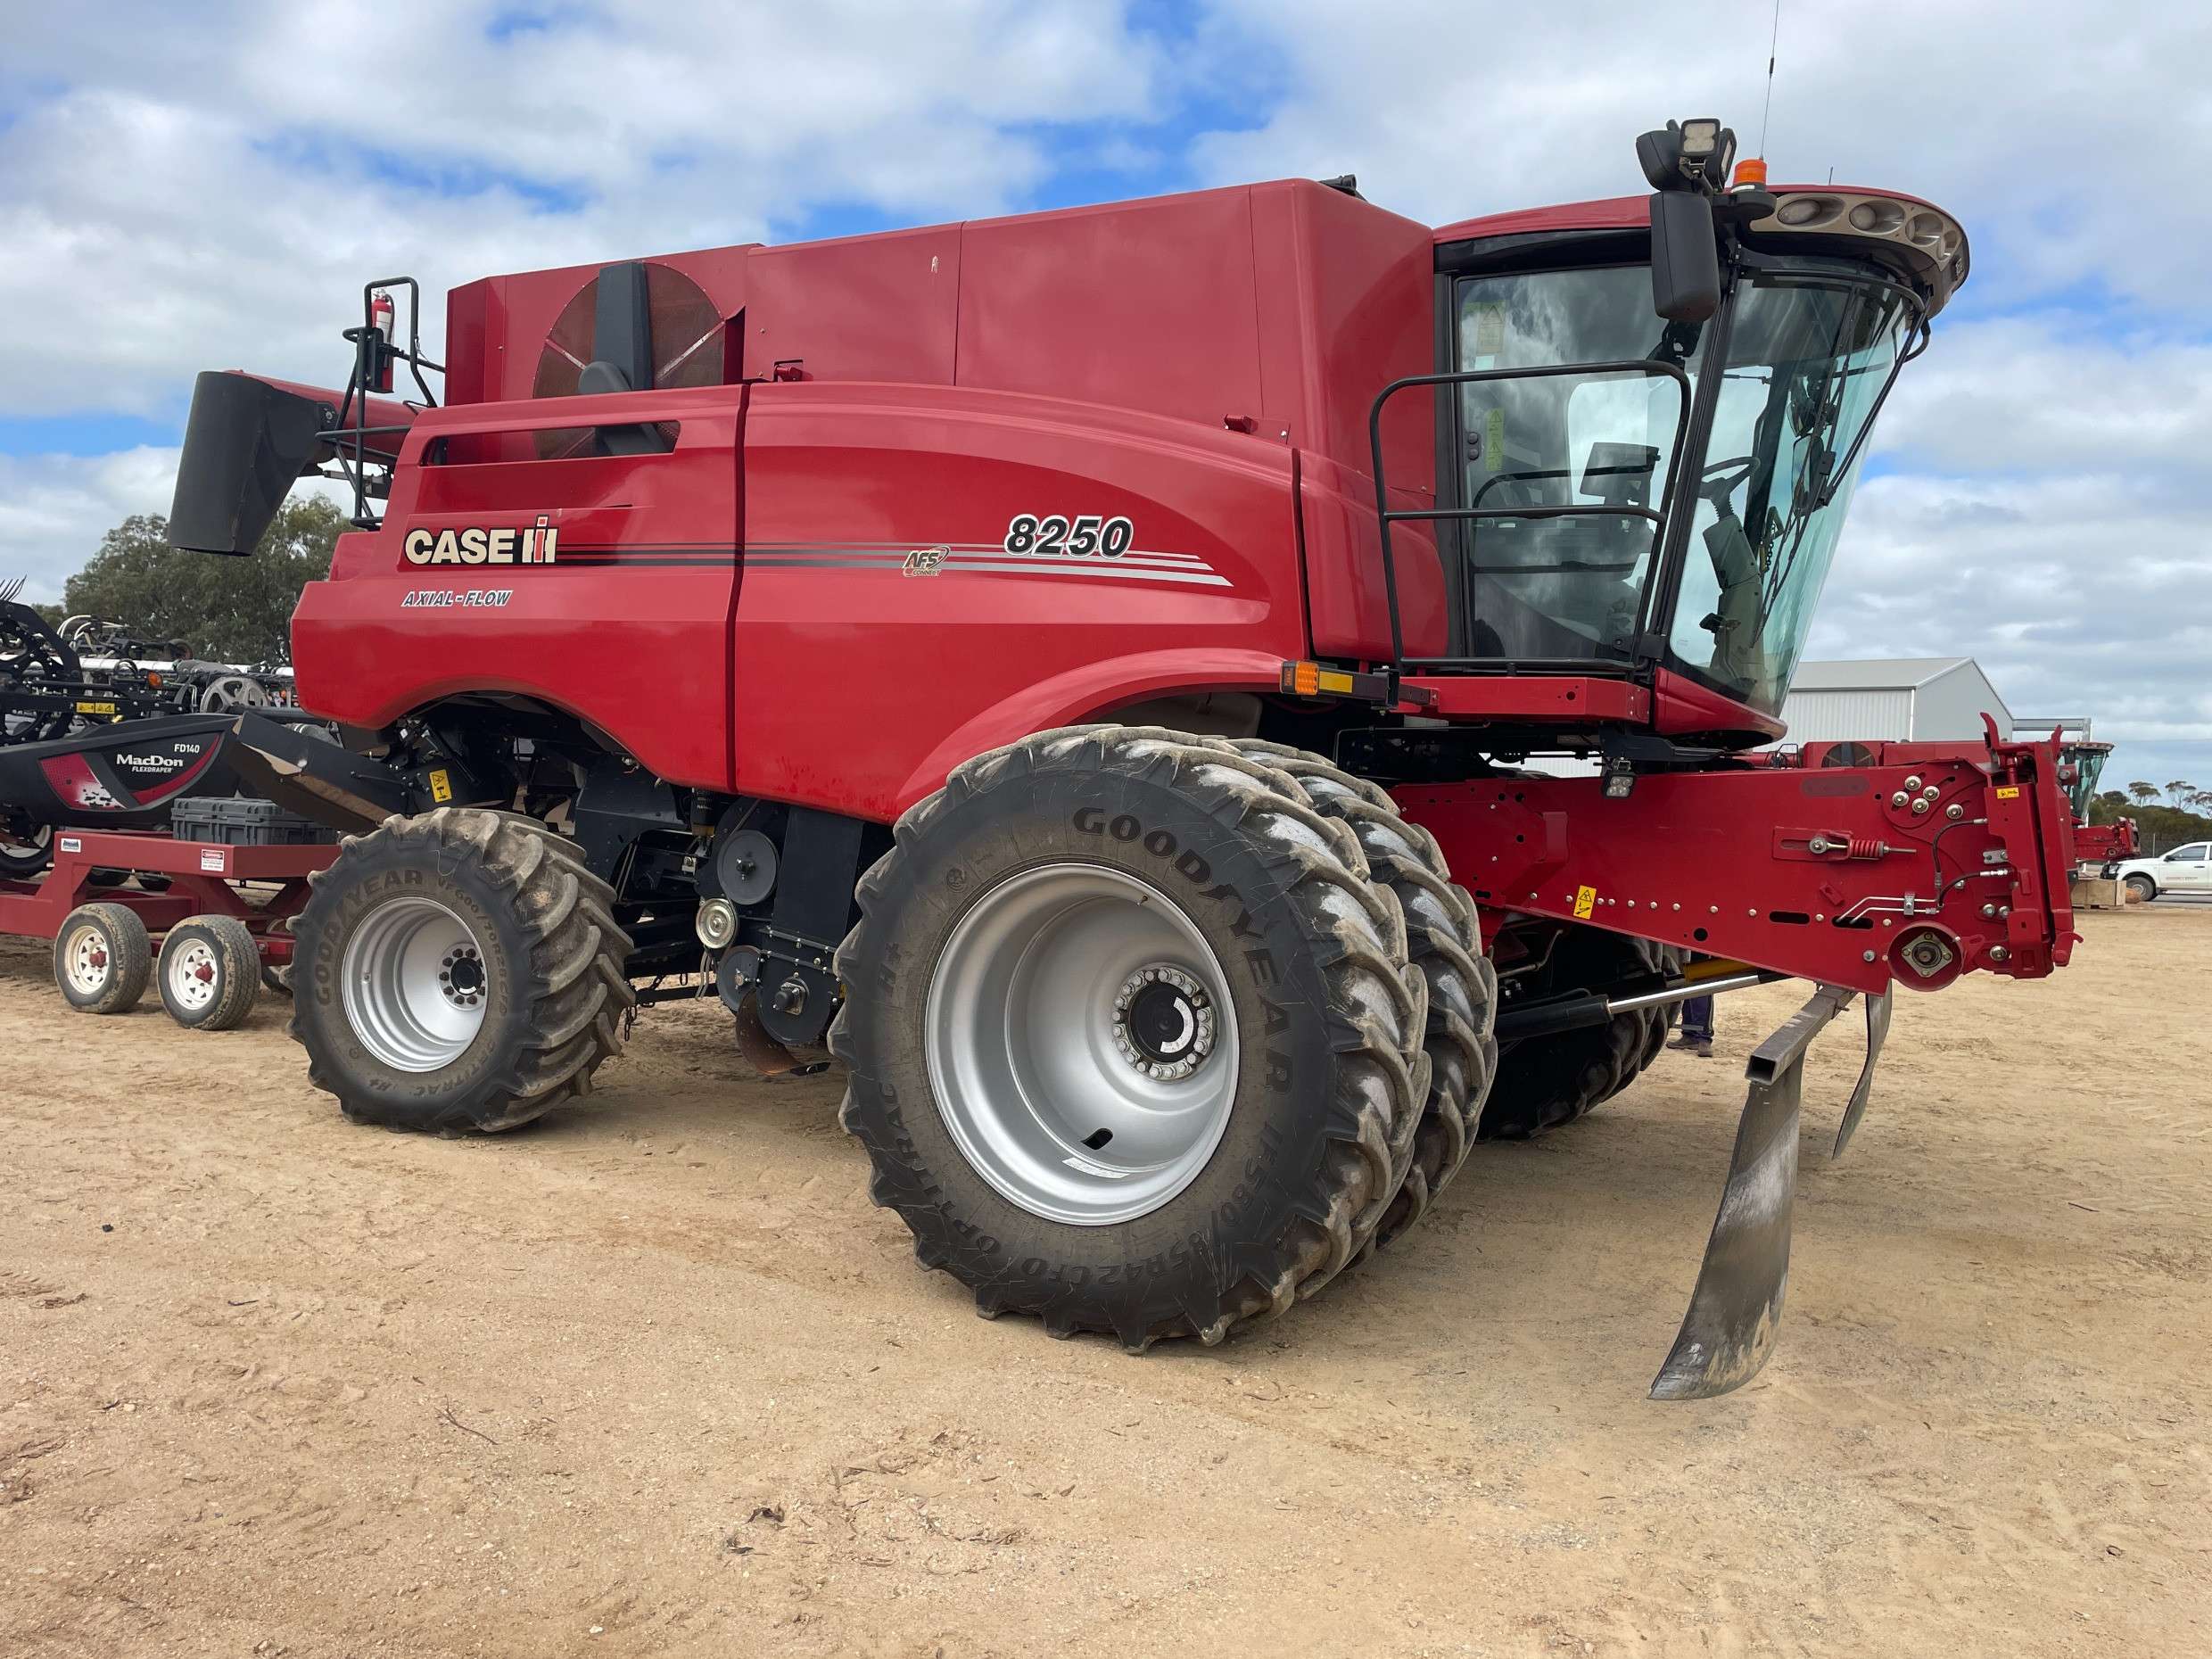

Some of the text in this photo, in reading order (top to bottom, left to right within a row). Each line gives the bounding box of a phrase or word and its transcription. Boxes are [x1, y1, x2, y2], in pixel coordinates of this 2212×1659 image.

[404, 528, 516, 565] CASE
[1004, 514, 1134, 560] 8250
[902, 549, 942, 569] AFS
[912, 568, 942, 577] CONNECT
[400, 589, 514, 607] AXIAL-FLOW
[174, 743, 201, 754] FD140
[116, 754, 184, 767] MacDon
[316, 869, 424, 1006] GOODYEAR
[1073, 807, 1293, 1094] GOODYEAR
